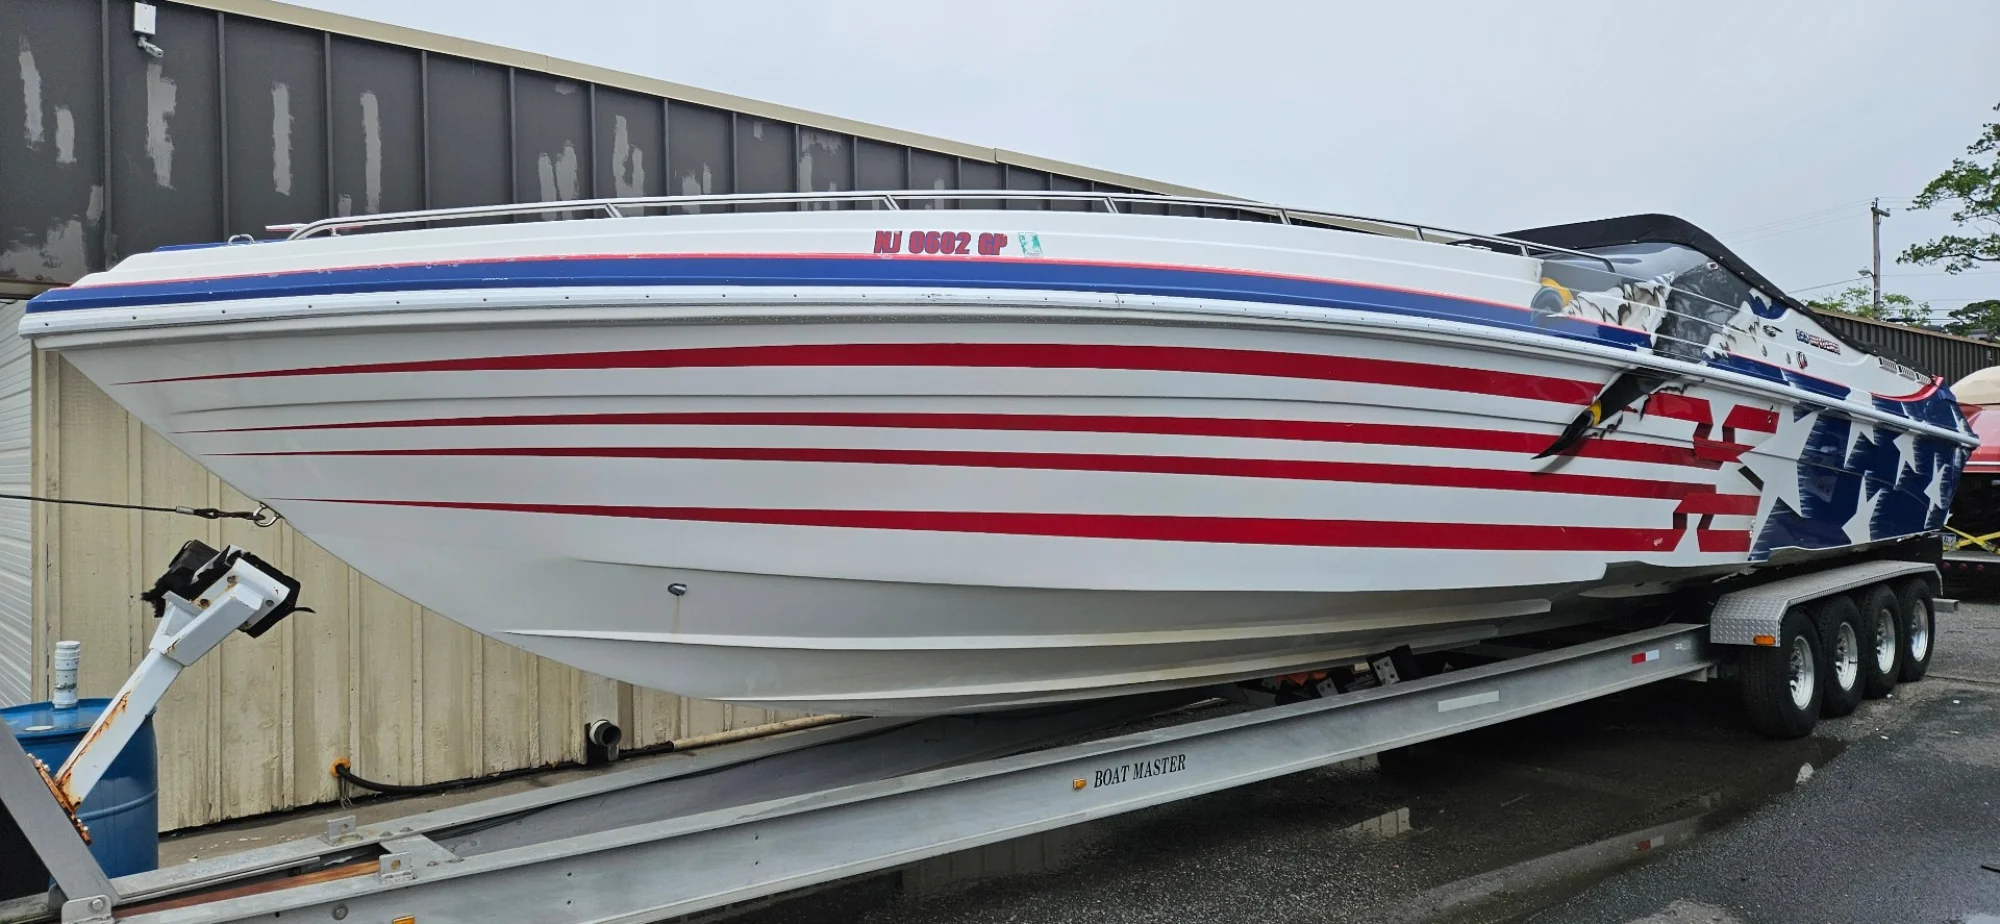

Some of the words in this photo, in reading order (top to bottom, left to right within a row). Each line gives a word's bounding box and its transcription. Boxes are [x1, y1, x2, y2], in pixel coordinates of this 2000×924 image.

[873, 230, 902, 254] NJ
[908, 230, 972, 255] 0602
[977, 232, 1008, 256] GP
[1093, 764, 1130, 789] BOAT
[1132, 753, 1187, 780] MASTER
